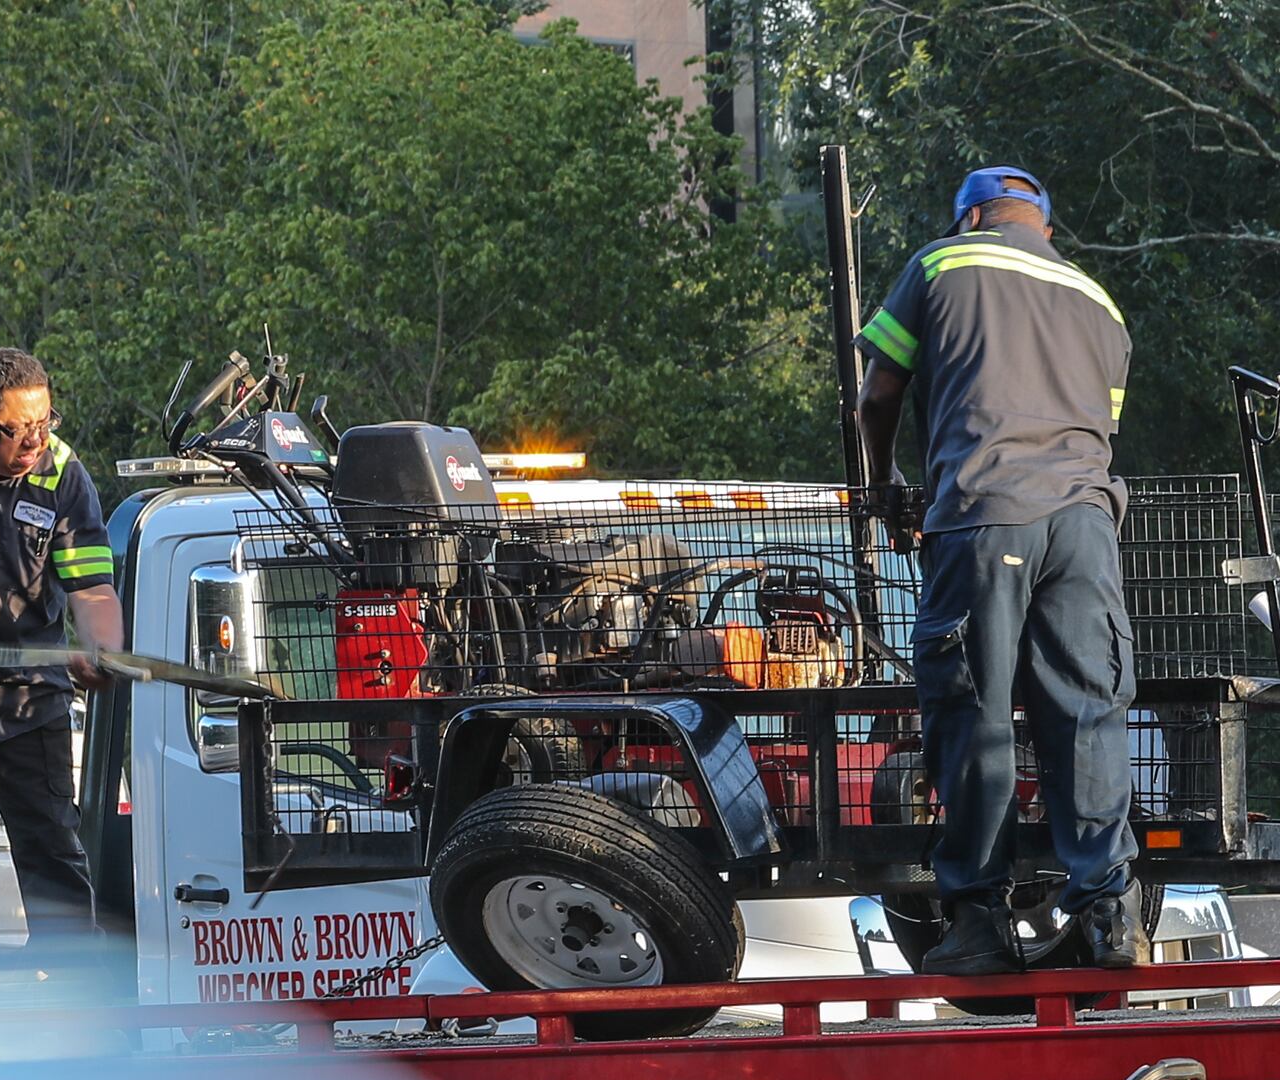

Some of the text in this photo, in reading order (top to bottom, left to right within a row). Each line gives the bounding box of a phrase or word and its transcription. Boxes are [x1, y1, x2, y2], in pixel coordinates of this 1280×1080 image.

[344, 604, 398, 618] S-SERIES
[192, 910, 416, 966] BROWN & BROWN
